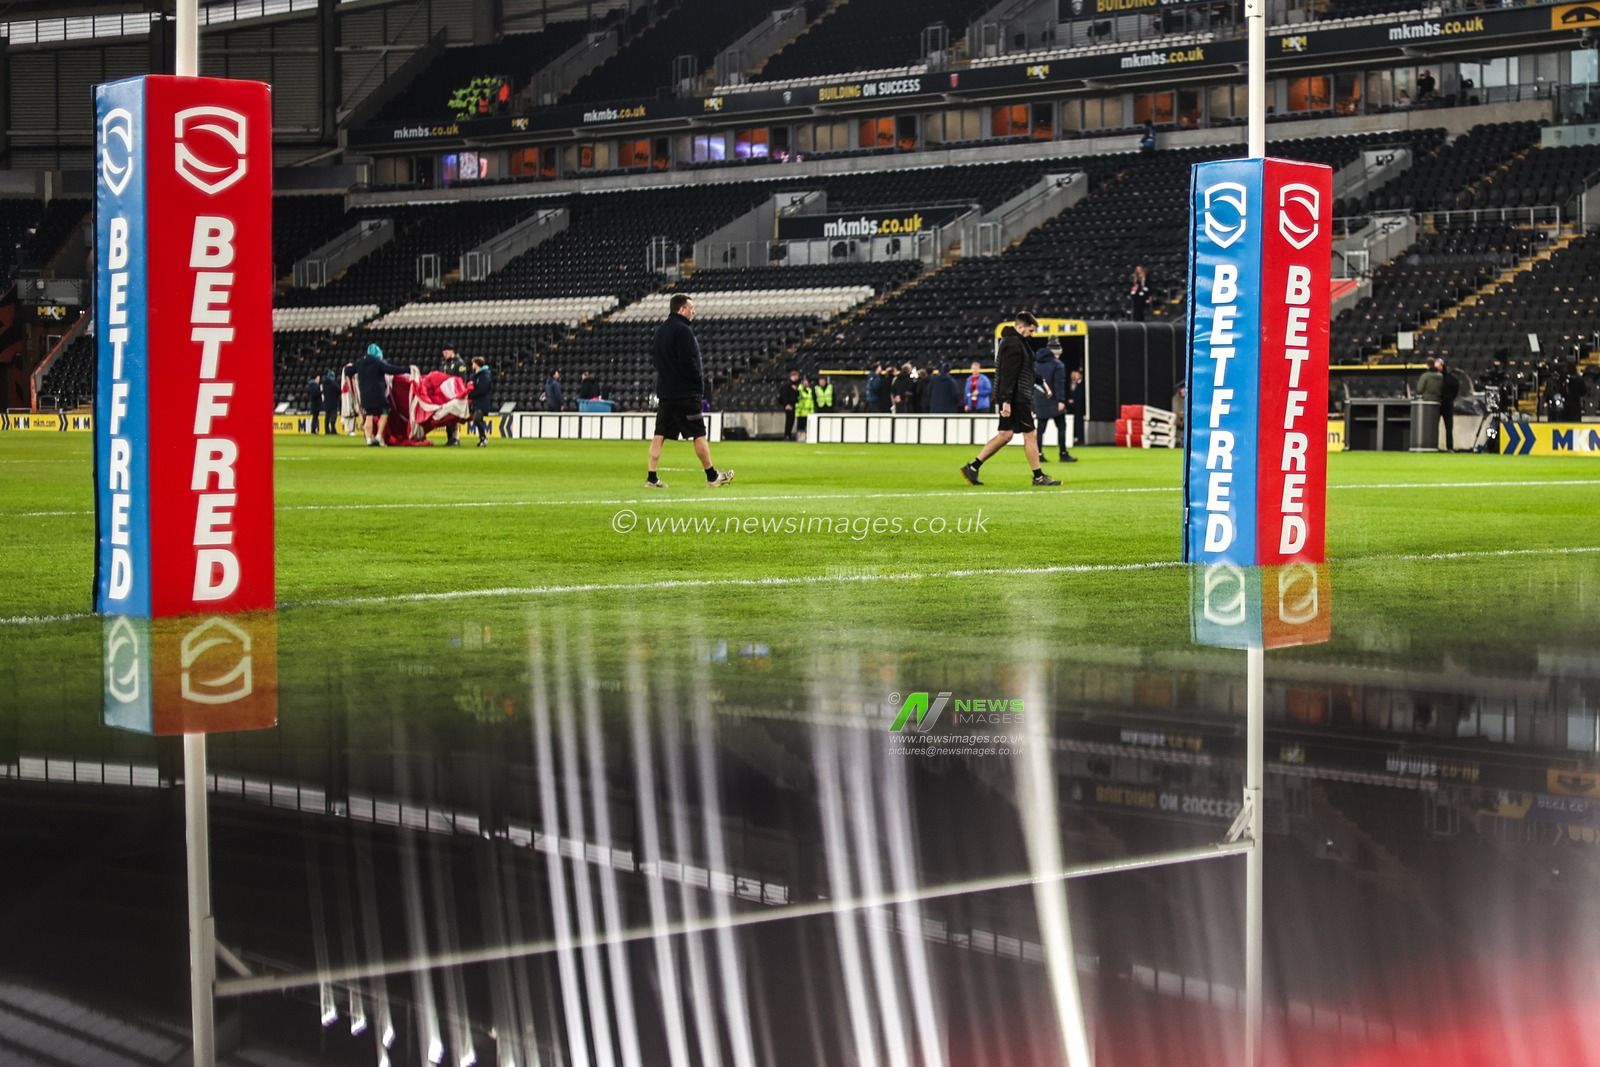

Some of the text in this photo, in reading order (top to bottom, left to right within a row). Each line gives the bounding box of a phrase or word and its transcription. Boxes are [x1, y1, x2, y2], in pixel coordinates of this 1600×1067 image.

[1388, 17, 1484, 41] mkmbs.co.uk
[1120, 47, 1205, 69] mkmbs.co.uk
[818, 78, 921, 101] BUILDING ON SUCCESS
[583, 105, 646, 123] mkmbs.co.uk
[393, 124, 460, 139] mkmbs.co.uk
[823, 213, 923, 238] mkmbs.co.uk
[37, 306, 66, 320] MKM
[108, 217, 132, 600] BETFRED
[188, 216, 240, 601] BETFRED
[1203, 264, 1239, 553] BETFRED
[1279, 265, 1311, 555] BETFRED
